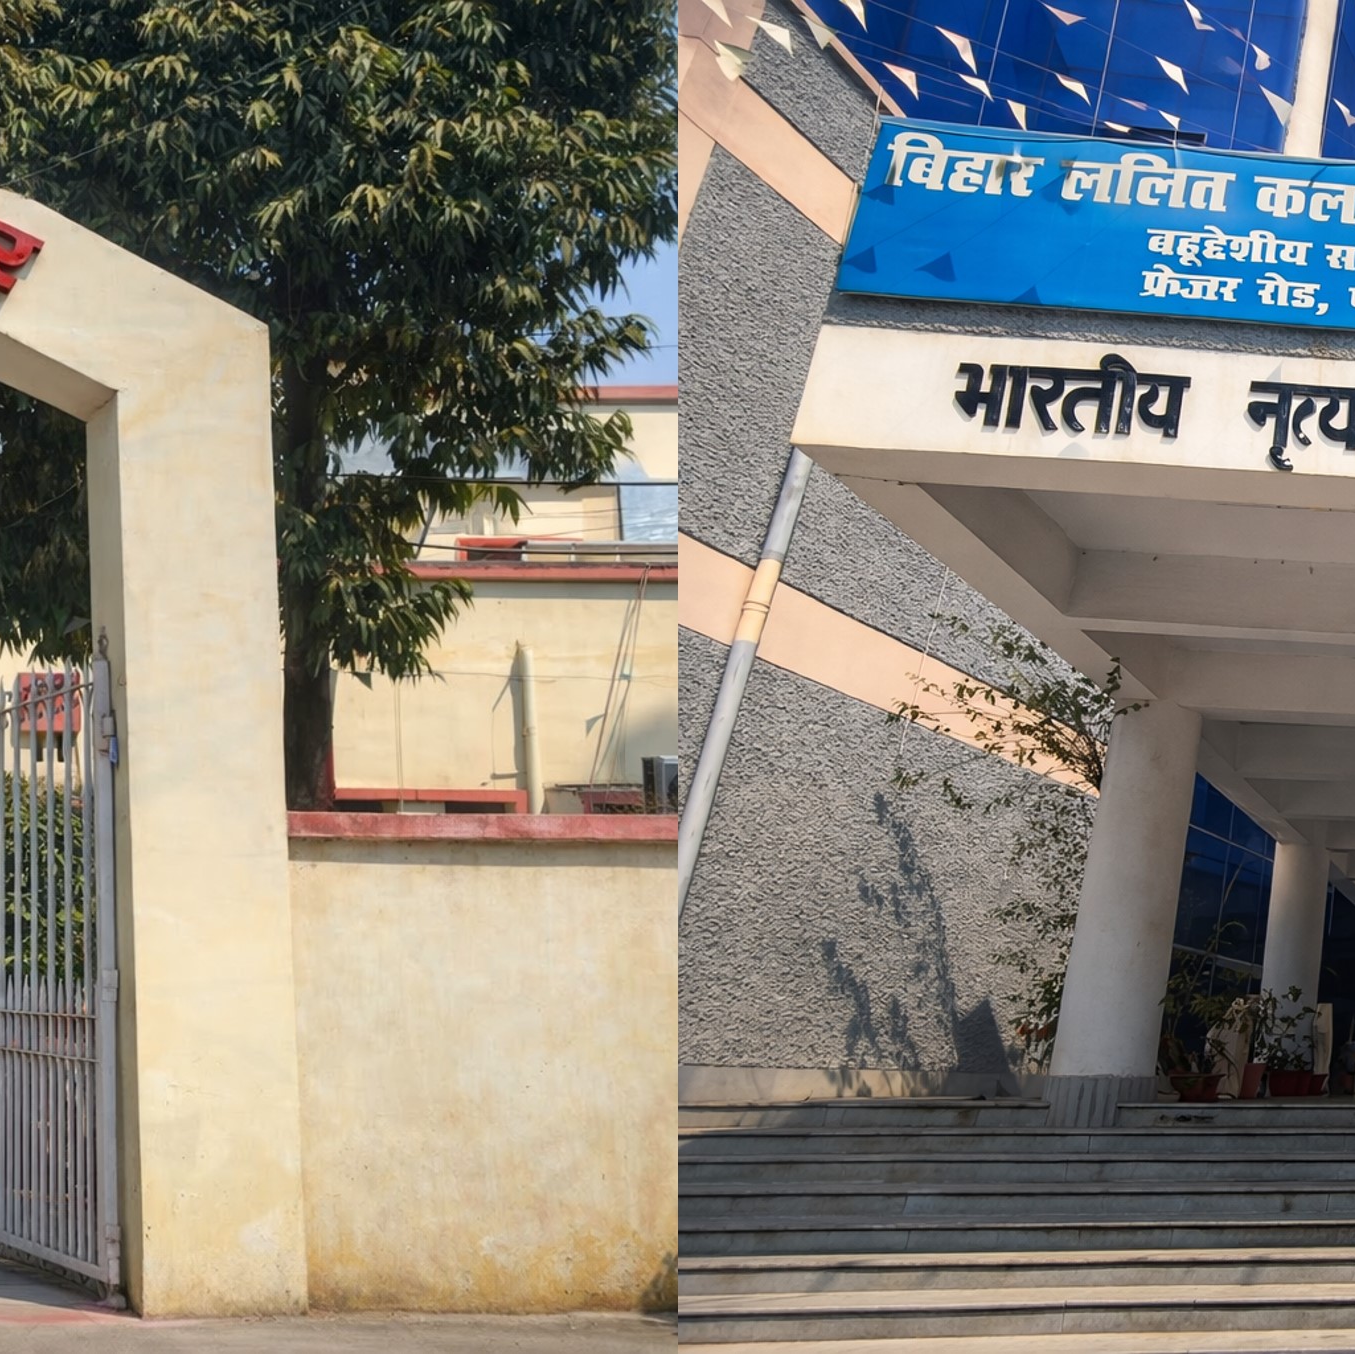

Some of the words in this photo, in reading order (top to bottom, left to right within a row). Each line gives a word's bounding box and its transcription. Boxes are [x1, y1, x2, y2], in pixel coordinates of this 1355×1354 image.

[887, 132, 1045, 197] बिहार
[1060, 153, 1236, 212] ललित
[1256, 272, 1329, 316] रोड,
[954, 354, 1192, 439] भारतीय
